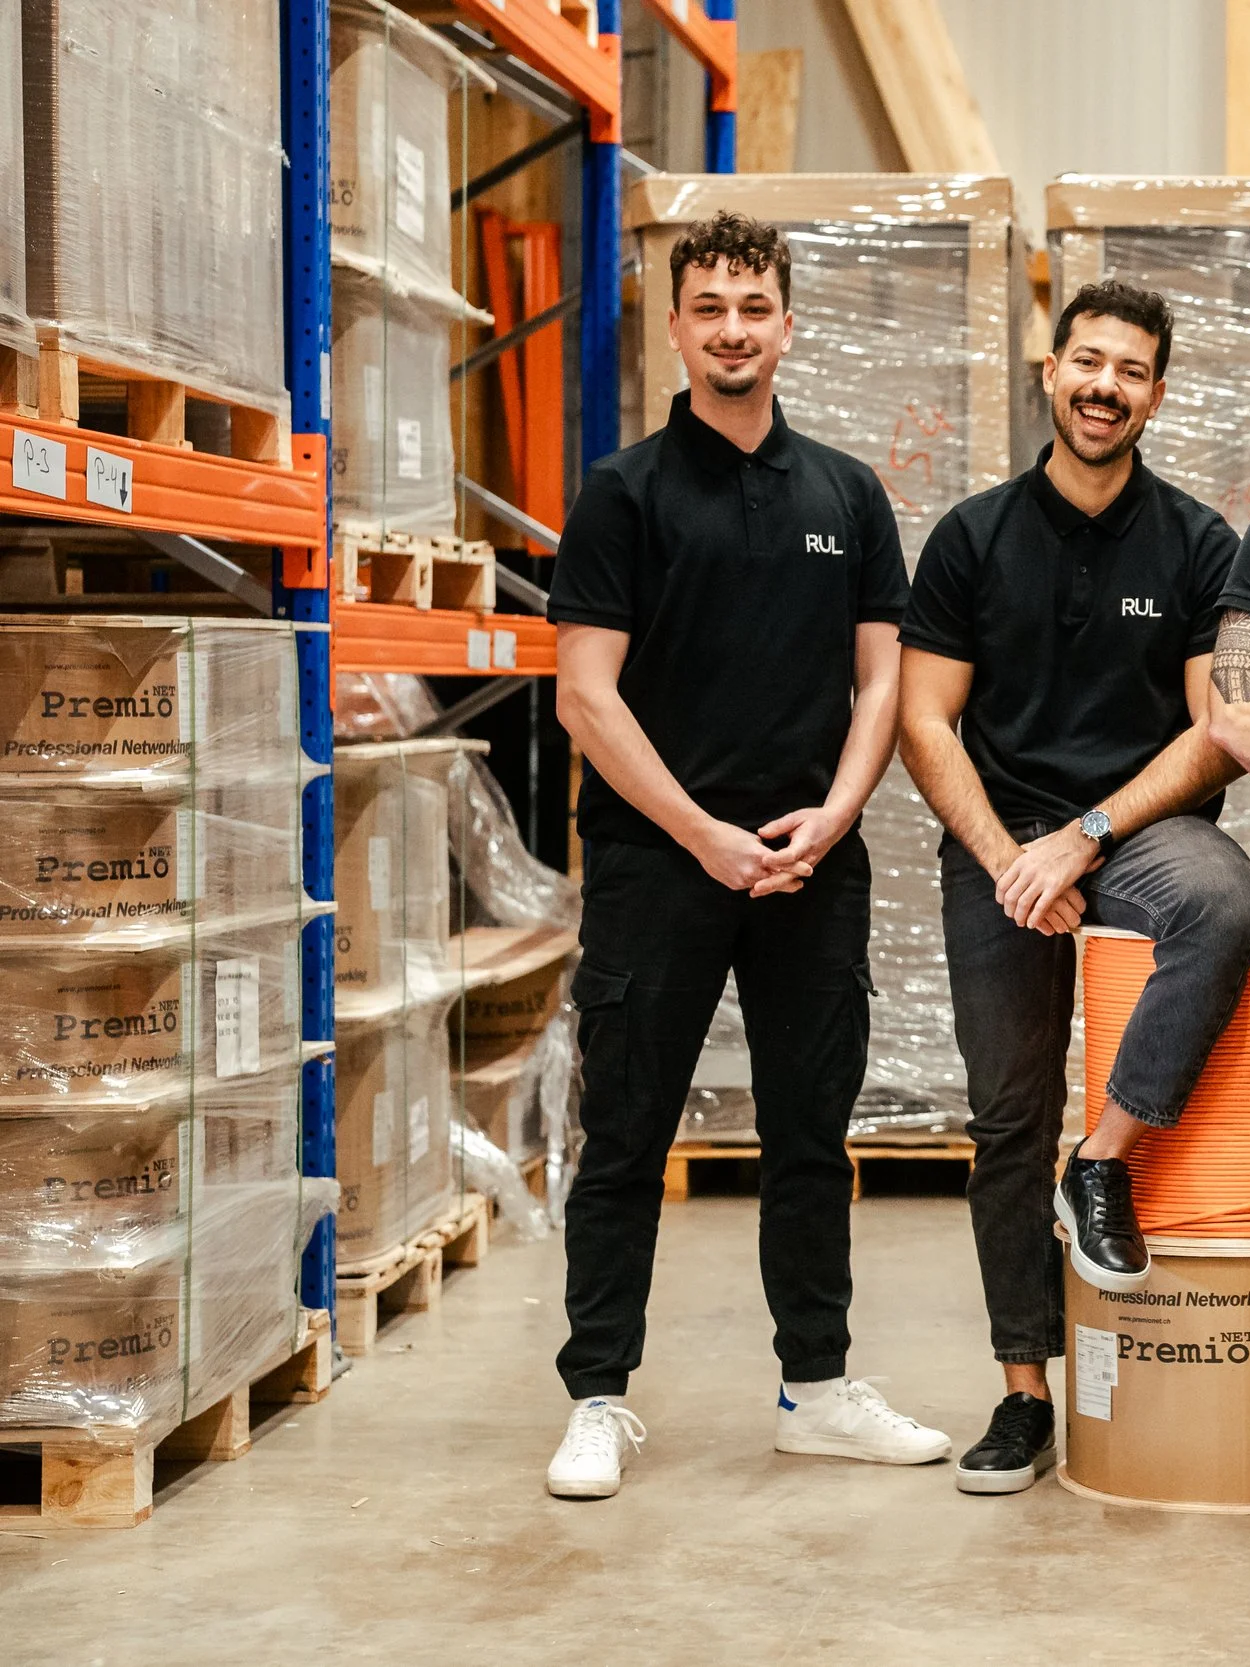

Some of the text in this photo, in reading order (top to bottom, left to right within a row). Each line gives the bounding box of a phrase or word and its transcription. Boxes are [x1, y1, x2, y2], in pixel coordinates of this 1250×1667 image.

[23, 438, 50, 476] P-3
[805, 533, 844, 555] RUL
[1121, 597, 1162, 617] RUL
[41, 686, 176, 718] Premio NET
[5, 739, 192, 758] Professional Networking
[35, 847, 172, 882] Premio NET
[53, 999, 180, 1040] Premio NET
[47, 1324, 171, 1365] Premio
[1117, 1333, 1250, 1364] Premio
